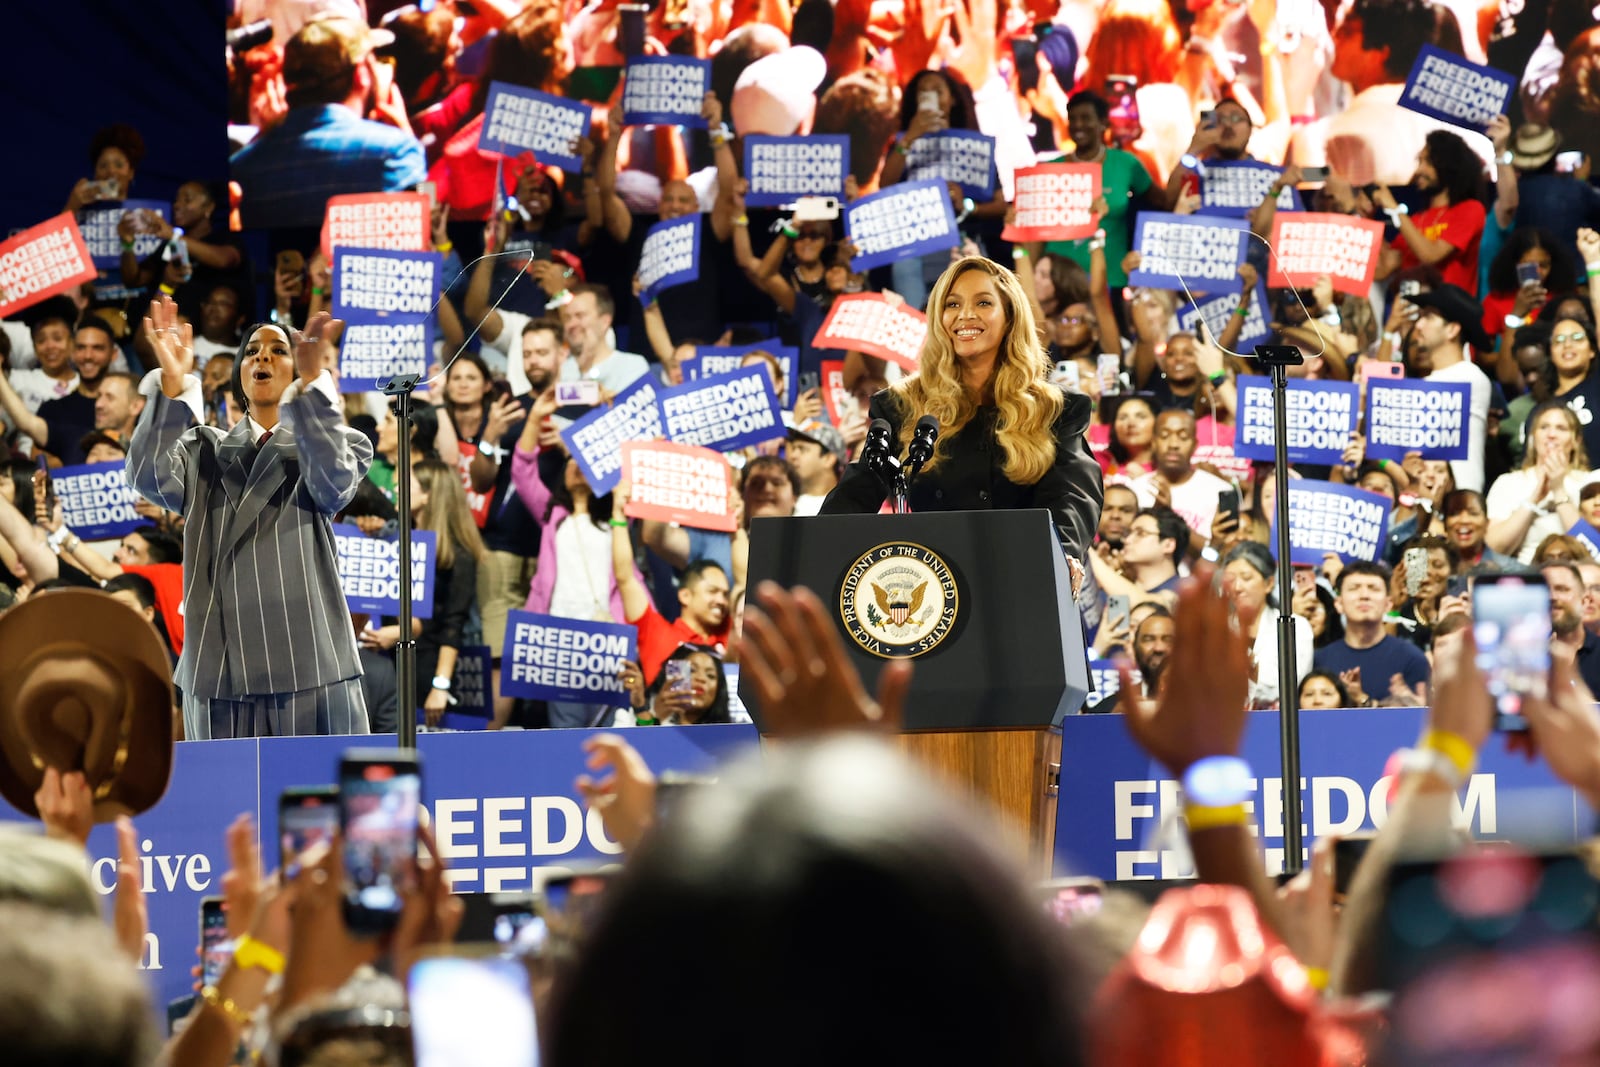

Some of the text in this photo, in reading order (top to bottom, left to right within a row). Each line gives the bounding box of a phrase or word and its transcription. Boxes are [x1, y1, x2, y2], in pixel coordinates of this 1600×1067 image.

[628, 63, 704, 82] FREEDOM
[1423, 54, 1509, 99] FREEDOM
[626, 80, 704, 99] FREEDOM
[1416, 69, 1503, 115] FREEDOM
[495, 92, 585, 126] FREEDOM
[624, 96, 704, 115] FREEDOM
[752, 143, 841, 161] FREEDOM
[752, 160, 841, 177] FREEDOM
[752, 177, 841, 193] FREEDOM
[329, 202, 422, 221] FREEDOM
[849, 186, 941, 226] FREEDOM
[1205, 193, 1294, 210] FREEDM
[330, 218, 422, 238] FREEDOM
[850, 202, 947, 240] FREEDOM
[1143, 221, 1240, 246] FREEDOM
[855, 218, 949, 257] FREEDOM
[1280, 222, 1373, 247] FREEDOM
[0, 226, 72, 273] FREEDO
[1141, 239, 1239, 263] FREEDOM
[1279, 239, 1371, 264] FREEDOM
[341, 255, 434, 279] FREEDOM
[1139, 257, 1236, 281] FREEDOM
[1277, 256, 1367, 282] FREEDOM
[340, 273, 434, 296] FREEDOM
[340, 290, 433, 313] FREEDOM
[345, 324, 425, 343] FREEDOM
[342, 341, 426, 360] FREEDOM
[341, 359, 426, 379] FREEDOM
[663, 374, 765, 418] FREEDOM
[1244, 386, 1351, 412] FREDOM
[1372, 387, 1462, 411] FREEDOM
[572, 383, 657, 450] FREEDOM
[667, 392, 770, 435] FREEDOM
[1243, 405, 1350, 431] FREDOM
[1371, 407, 1462, 430] FREEDOM
[1242, 424, 1349, 450] FREDOM
[1371, 426, 1461, 449] FREEDOM
[630, 449, 725, 478] FREEDOM
[53, 469, 128, 494] REEDO
[631, 466, 727, 497] FREEDOM
[60, 487, 142, 510] REEDOM
[631, 484, 727, 516] FREEDOM
[1288, 489, 1384, 524] FREEDOM
[62, 505, 143, 527] REEDOM
[335, 536, 427, 562] REEDOM
[880, 547, 893, 558] OF
[897, 546, 918, 557] THE
[338, 555, 426, 581] REEDOM
[923, 552, 955, 599] UNITED
[342, 576, 425, 602] EEDOM
[843, 554, 873, 623] PRESIDENT
[515, 622, 629, 656] FREEDOM
[854, 625, 881, 653] VICE
[919, 606, 955, 650] STATES
[513, 643, 626, 676] FREEDOM
[511, 663, 625, 693] FREEDOM
[418, 796, 625, 859] EEDO
